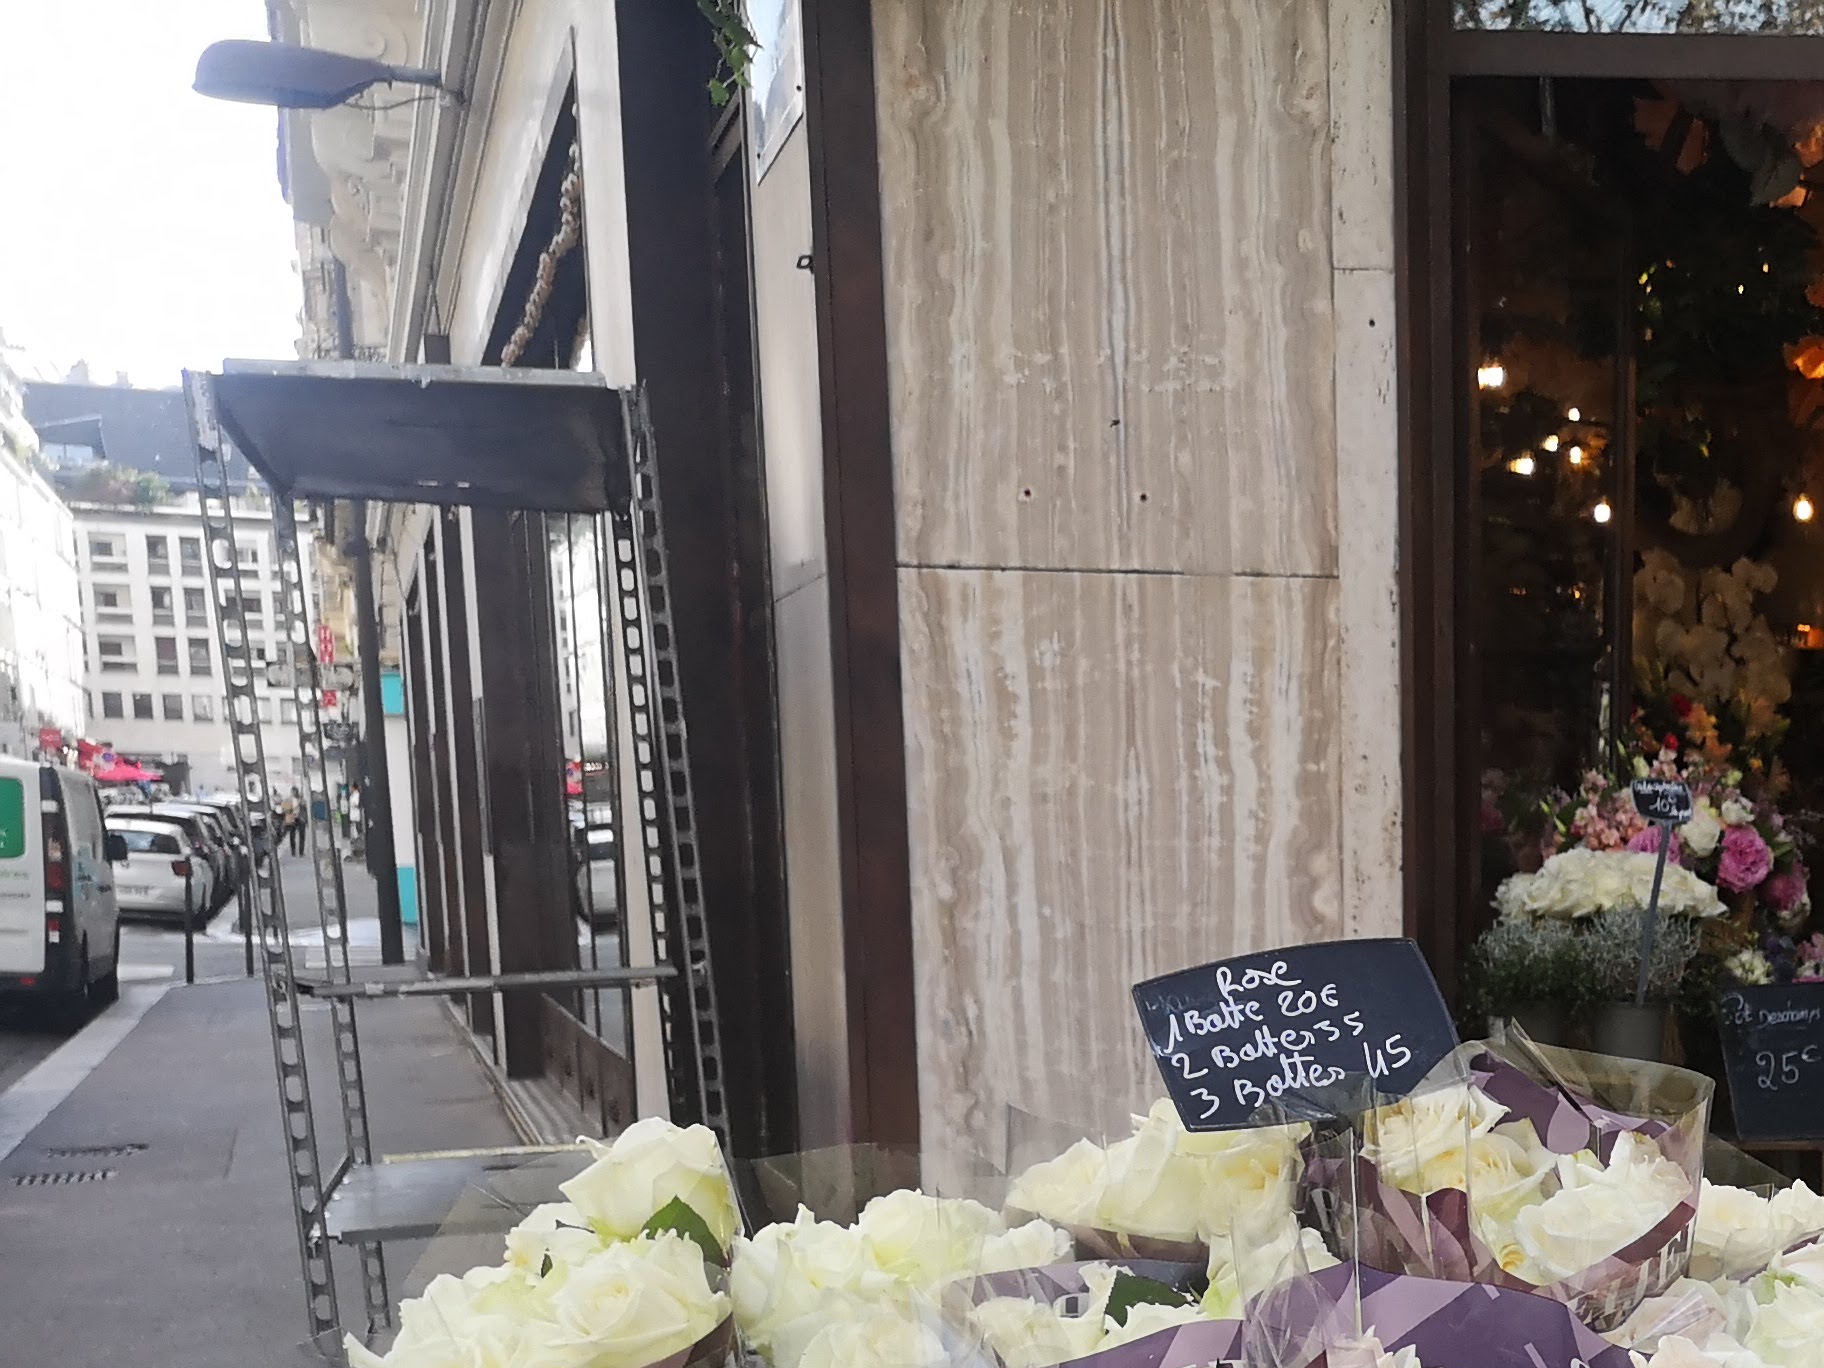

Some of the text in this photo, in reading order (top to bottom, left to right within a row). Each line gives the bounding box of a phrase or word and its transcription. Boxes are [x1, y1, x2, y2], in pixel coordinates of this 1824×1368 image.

[1216, 961, 1301, 999] Rose
[1171, 1053, 1208, 1080] 2
[1190, 1088, 1220, 1119] 3
